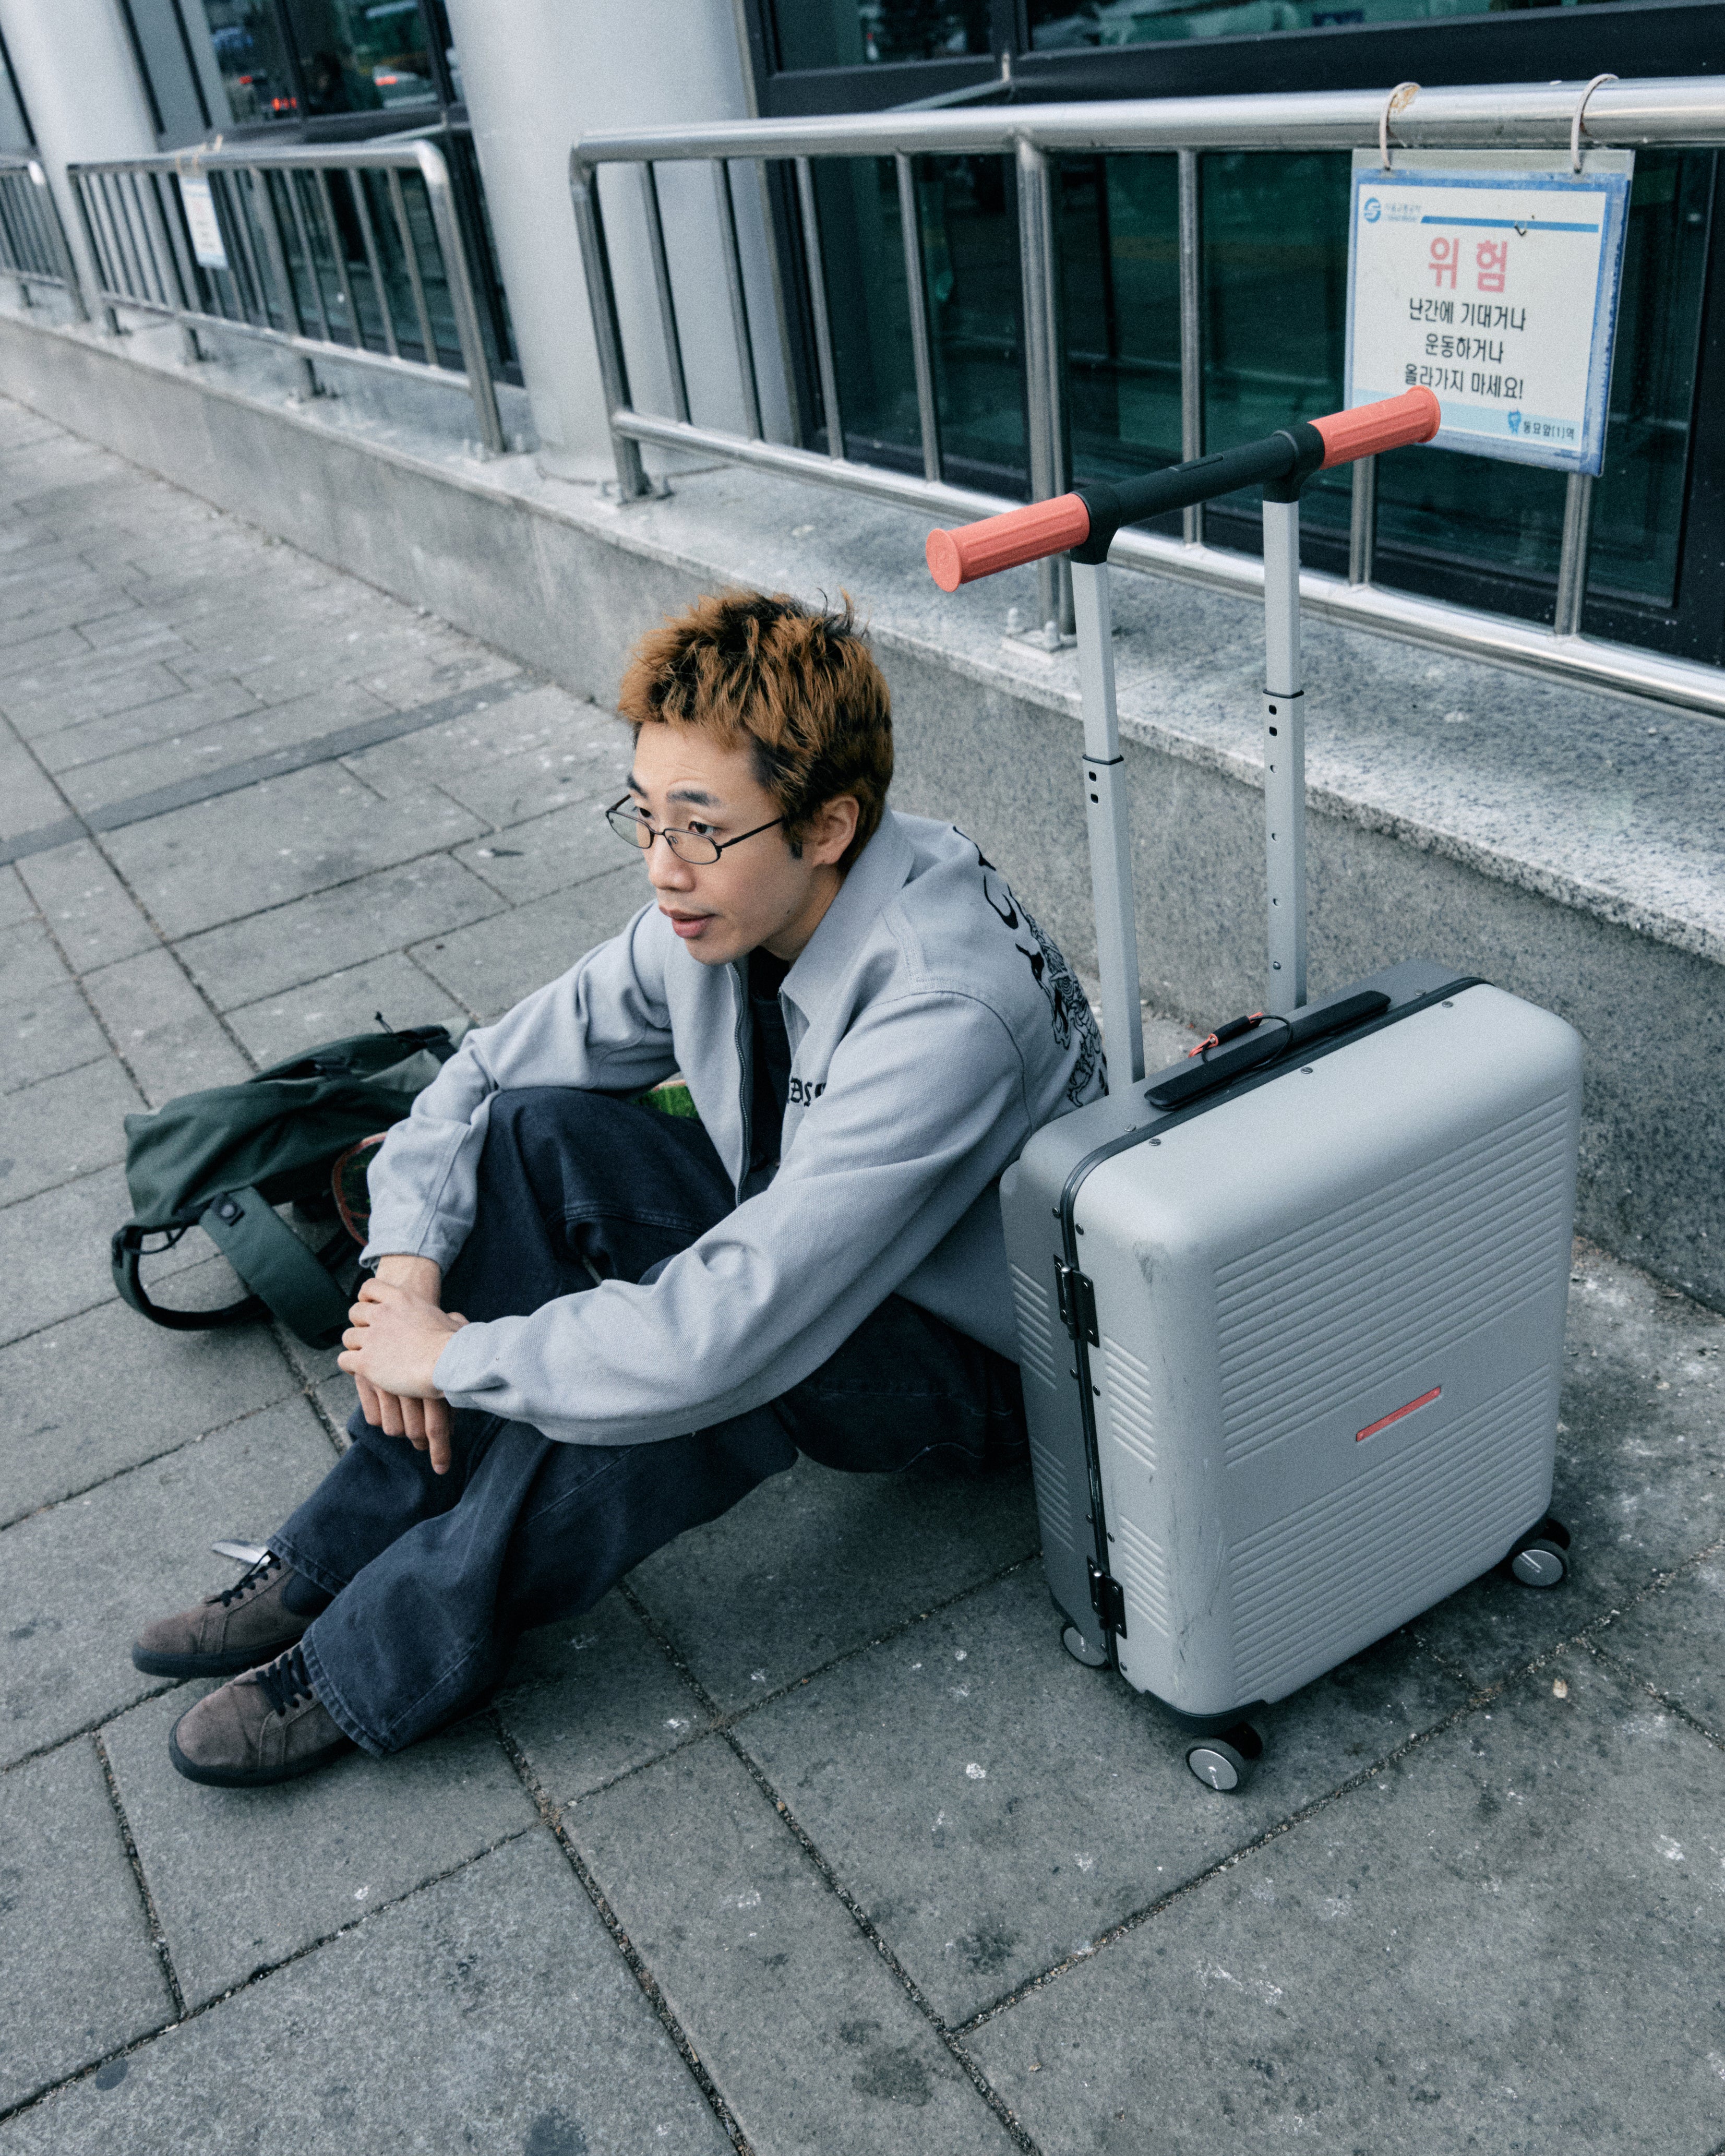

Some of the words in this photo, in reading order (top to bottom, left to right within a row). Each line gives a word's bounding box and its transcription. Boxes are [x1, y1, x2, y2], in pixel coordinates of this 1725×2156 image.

[1409, 297, 1454, 325] 난간에
[1461, 302, 1526, 331] 기대거나
[1425, 332, 1504, 364] 운동하거나
[1405, 363, 1464, 392] 올라가지
[1471, 372, 1524, 399] 마세요!
